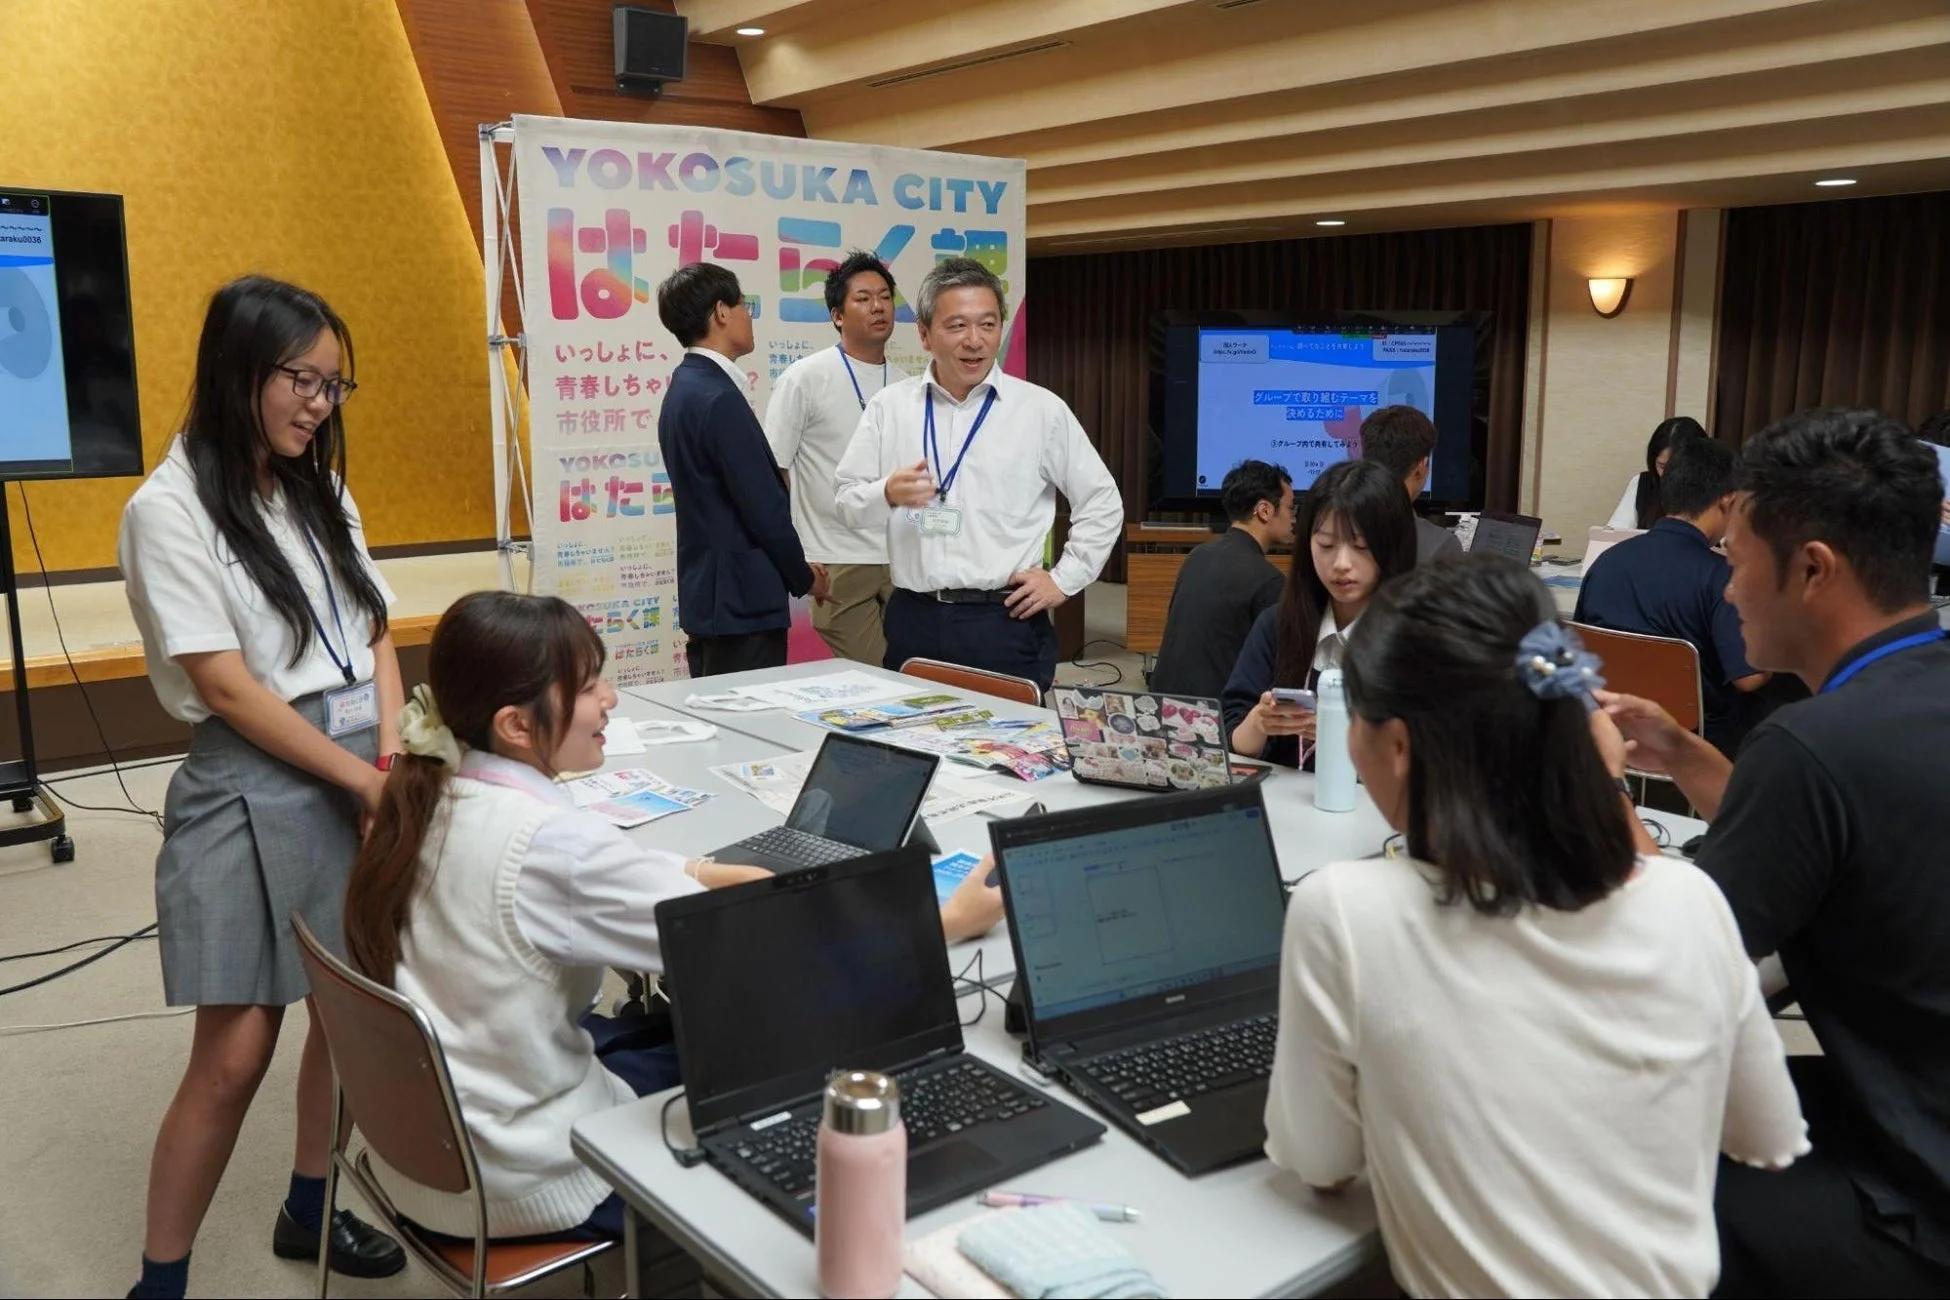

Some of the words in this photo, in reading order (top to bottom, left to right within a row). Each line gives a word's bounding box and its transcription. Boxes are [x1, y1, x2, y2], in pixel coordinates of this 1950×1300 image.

[542, 146, 878, 206] YOKOSUKA
[893, 172, 1008, 214] CITY
[555, 340, 669, 363] いっしょに、
[1287, 407, 1343, 419] 決めるために
[559, 452, 660, 472] YOKOSU
[559, 472, 677, 522] はたら
[578, 600, 630, 612] KOSUKA
[633, 596, 660, 607] CITY
[585, 606, 660, 634] たらく課
